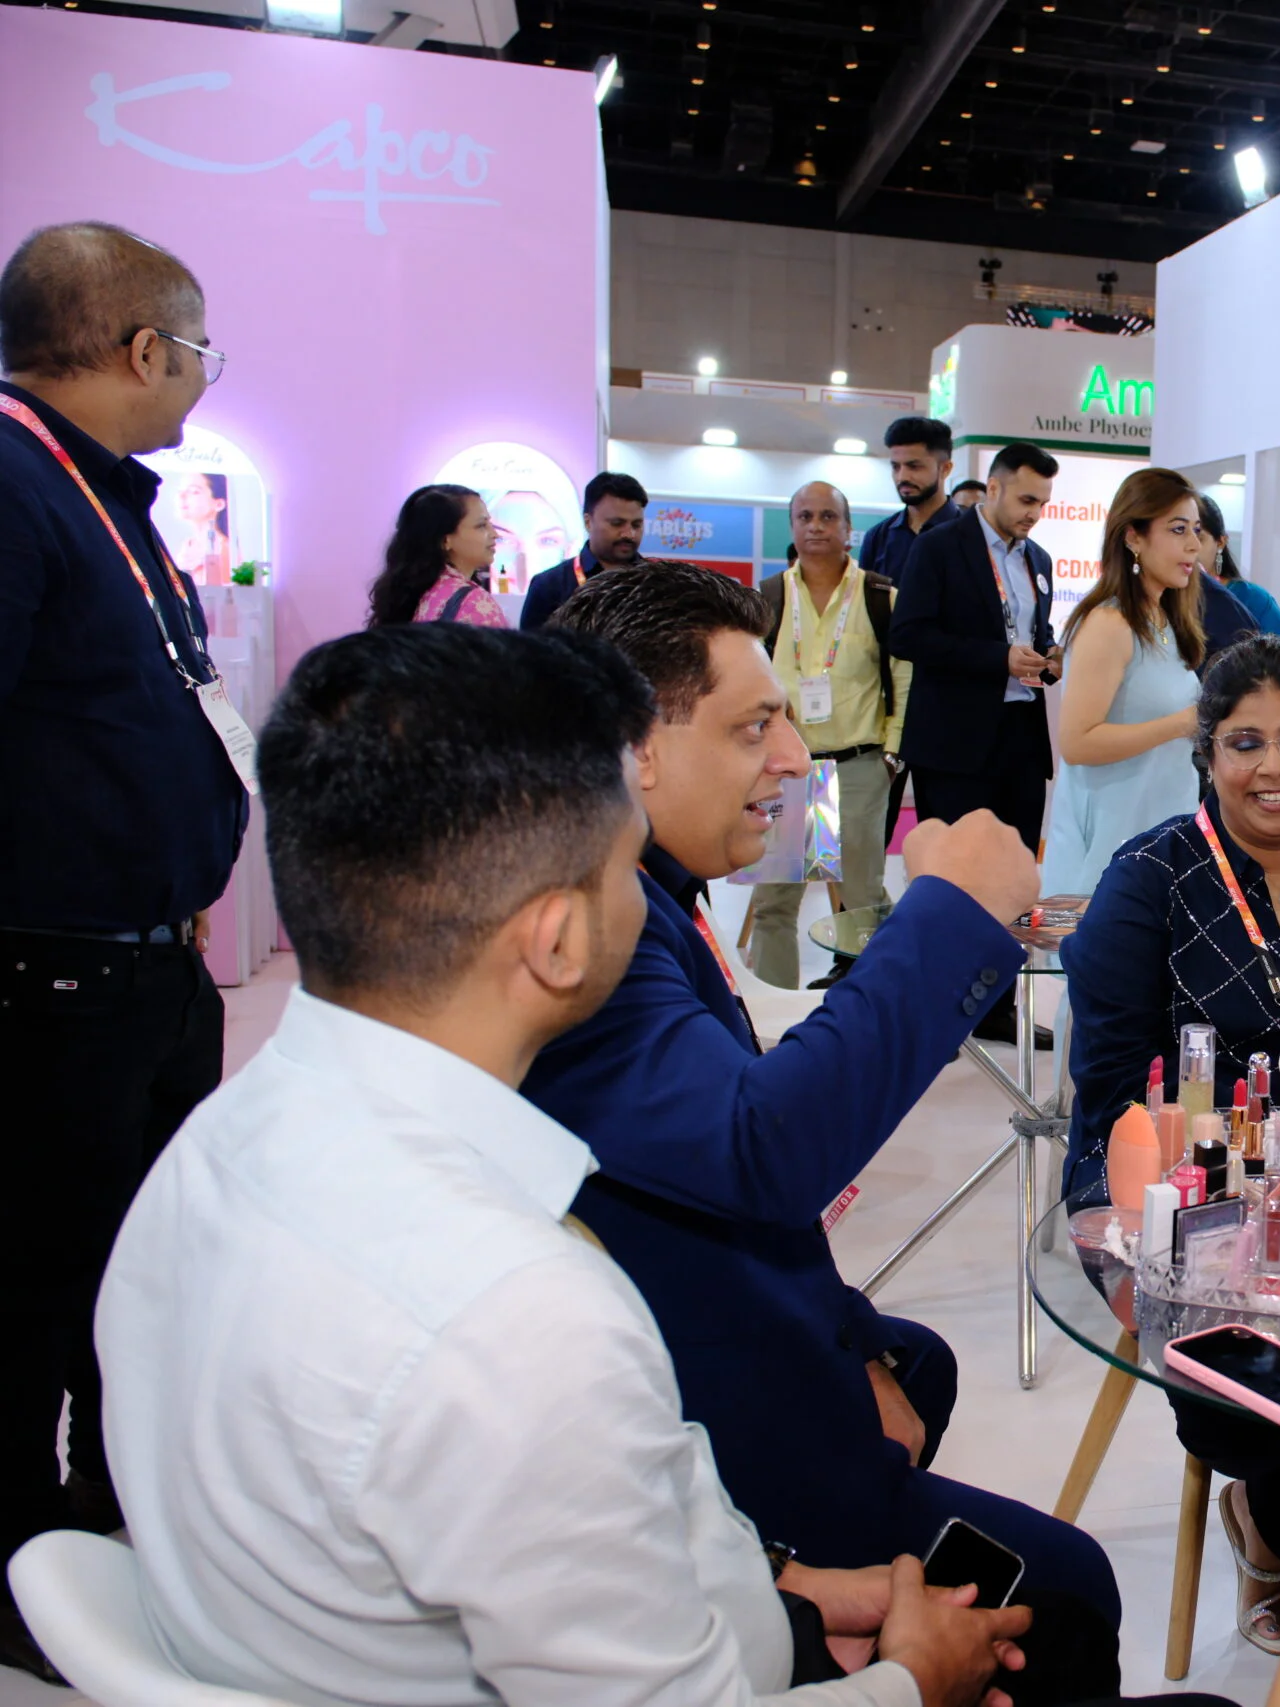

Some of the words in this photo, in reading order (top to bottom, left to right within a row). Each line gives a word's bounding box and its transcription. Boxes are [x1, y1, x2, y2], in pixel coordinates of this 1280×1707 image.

[84, 72, 501, 236] Kapco
[1031, 415, 1083, 433] Ambe
[645, 518, 713, 539] TABLETS
